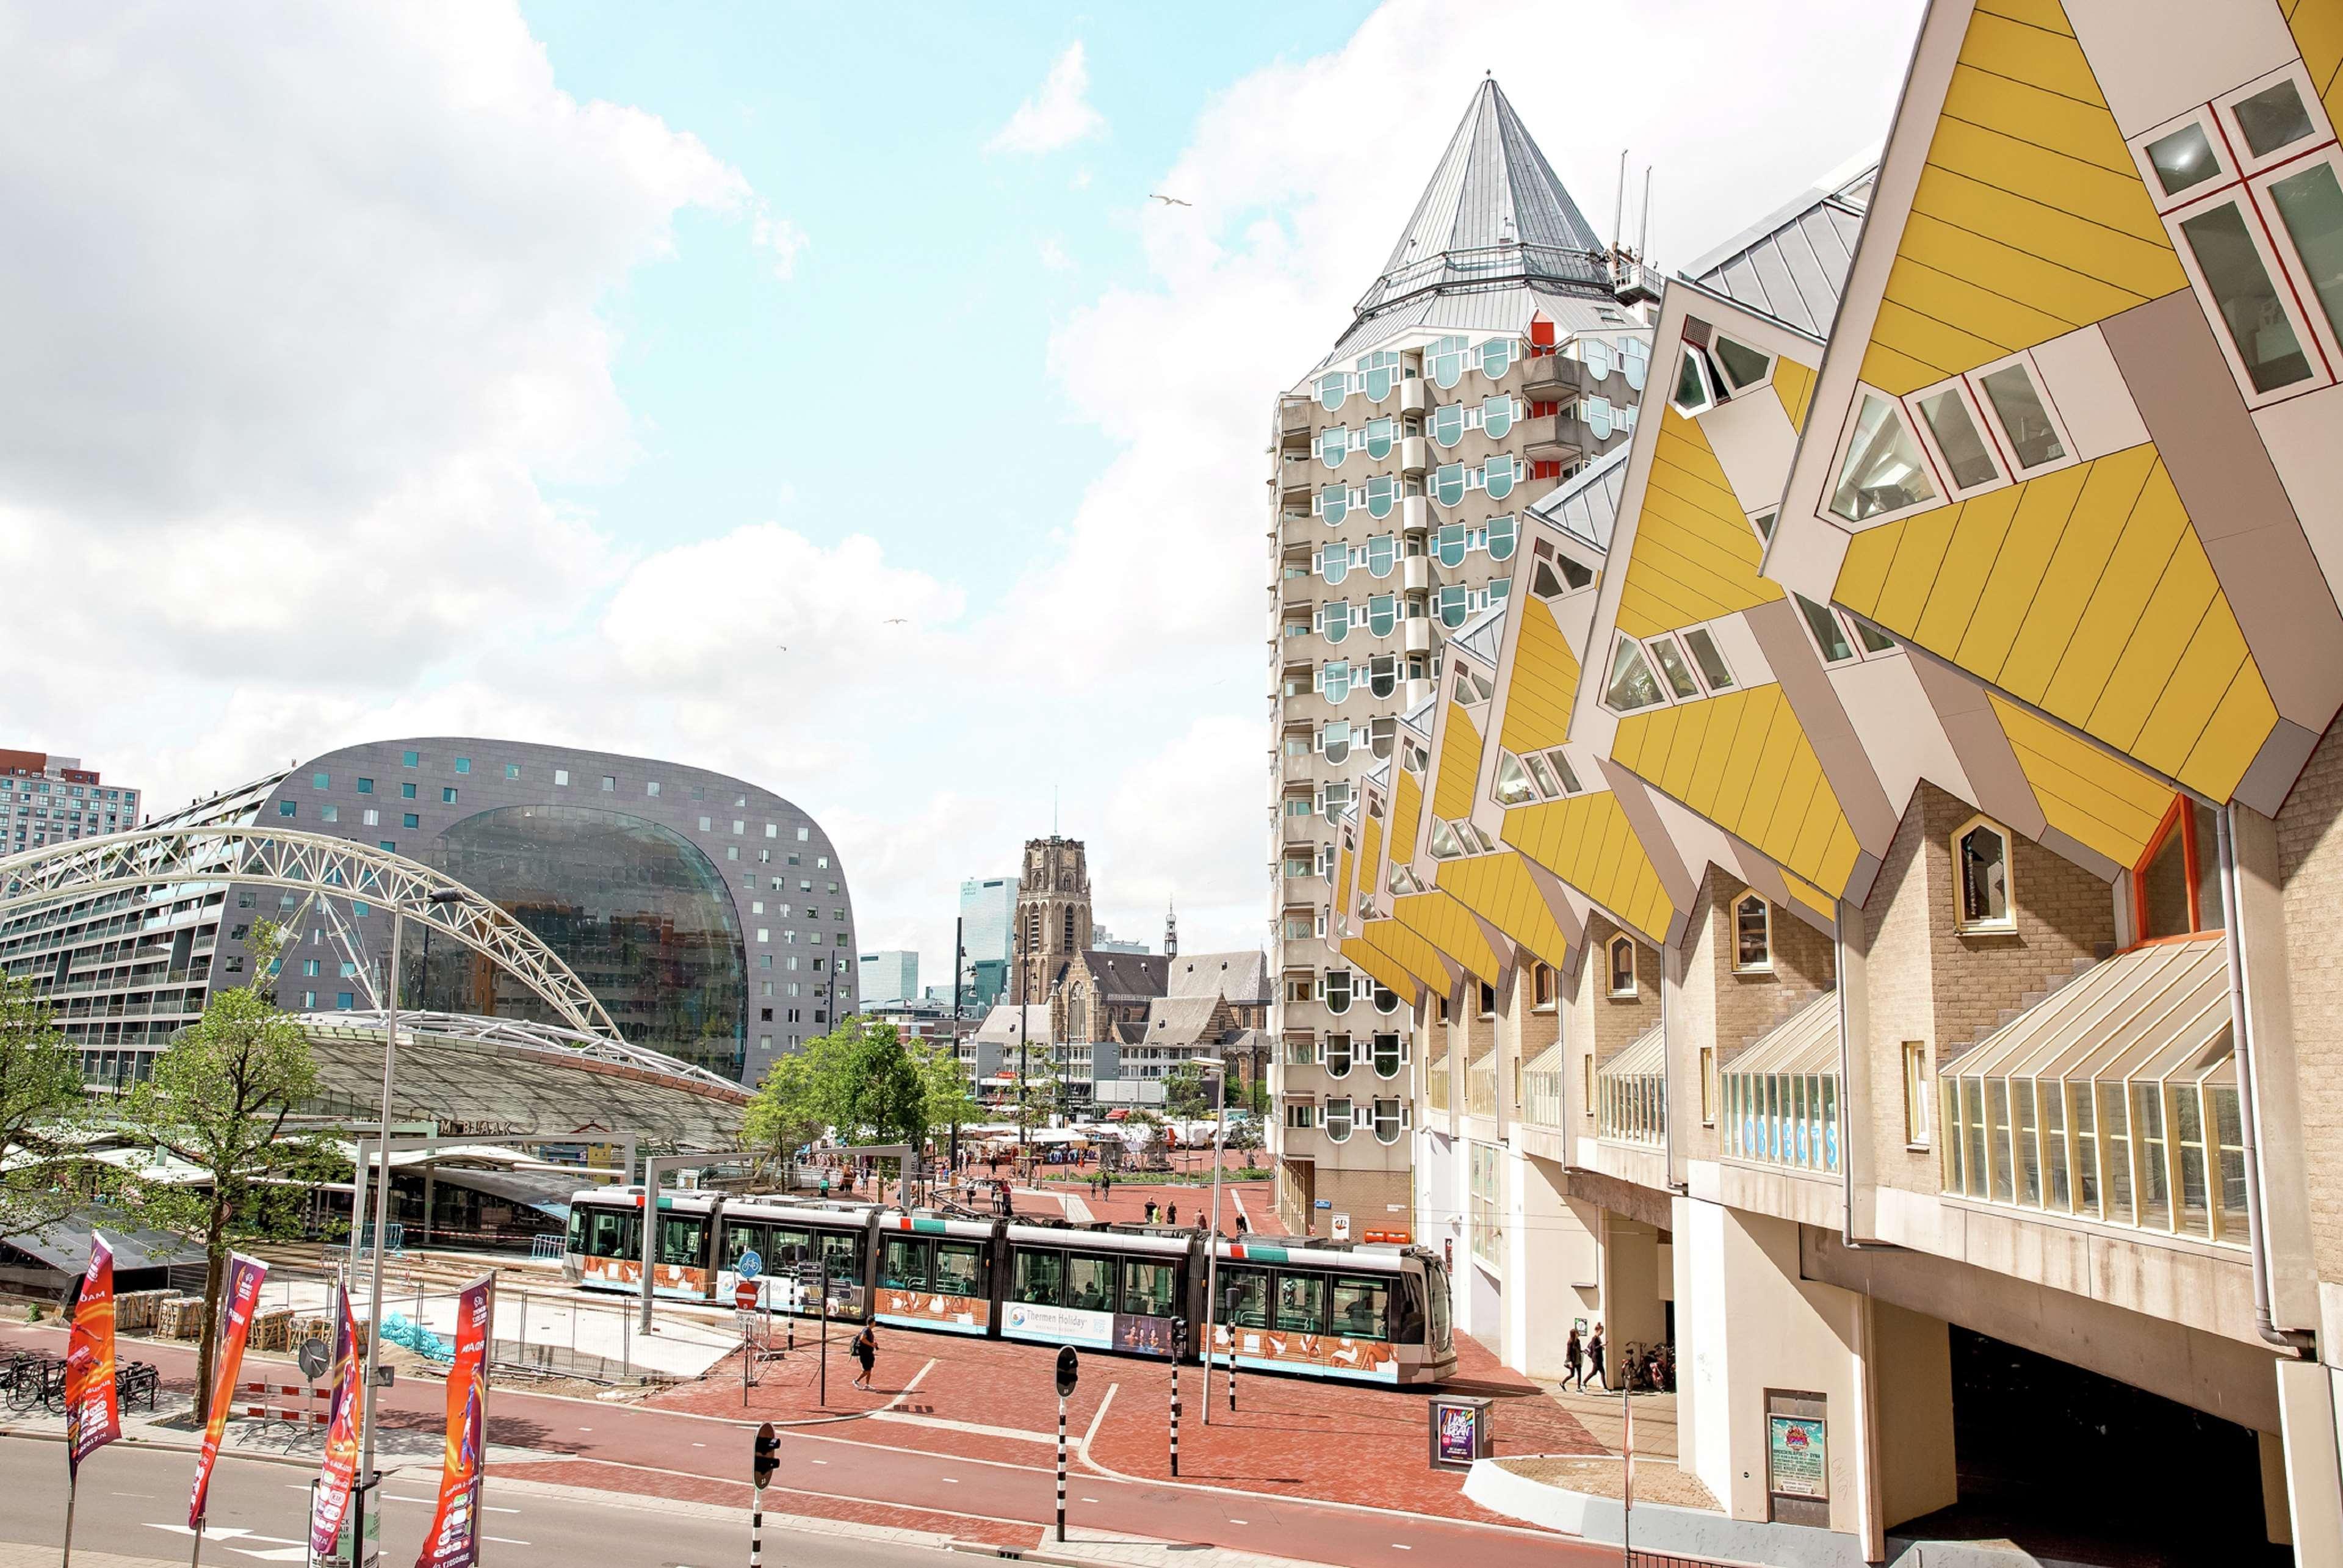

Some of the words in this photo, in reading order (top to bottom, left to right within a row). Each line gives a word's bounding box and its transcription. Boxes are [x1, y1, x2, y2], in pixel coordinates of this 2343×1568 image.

[463, 1121, 511, 1135] BLAAK
[1027, 1310, 1056, 1323] Thermen
[1058, 1313, 1086, 1329] Holiday
